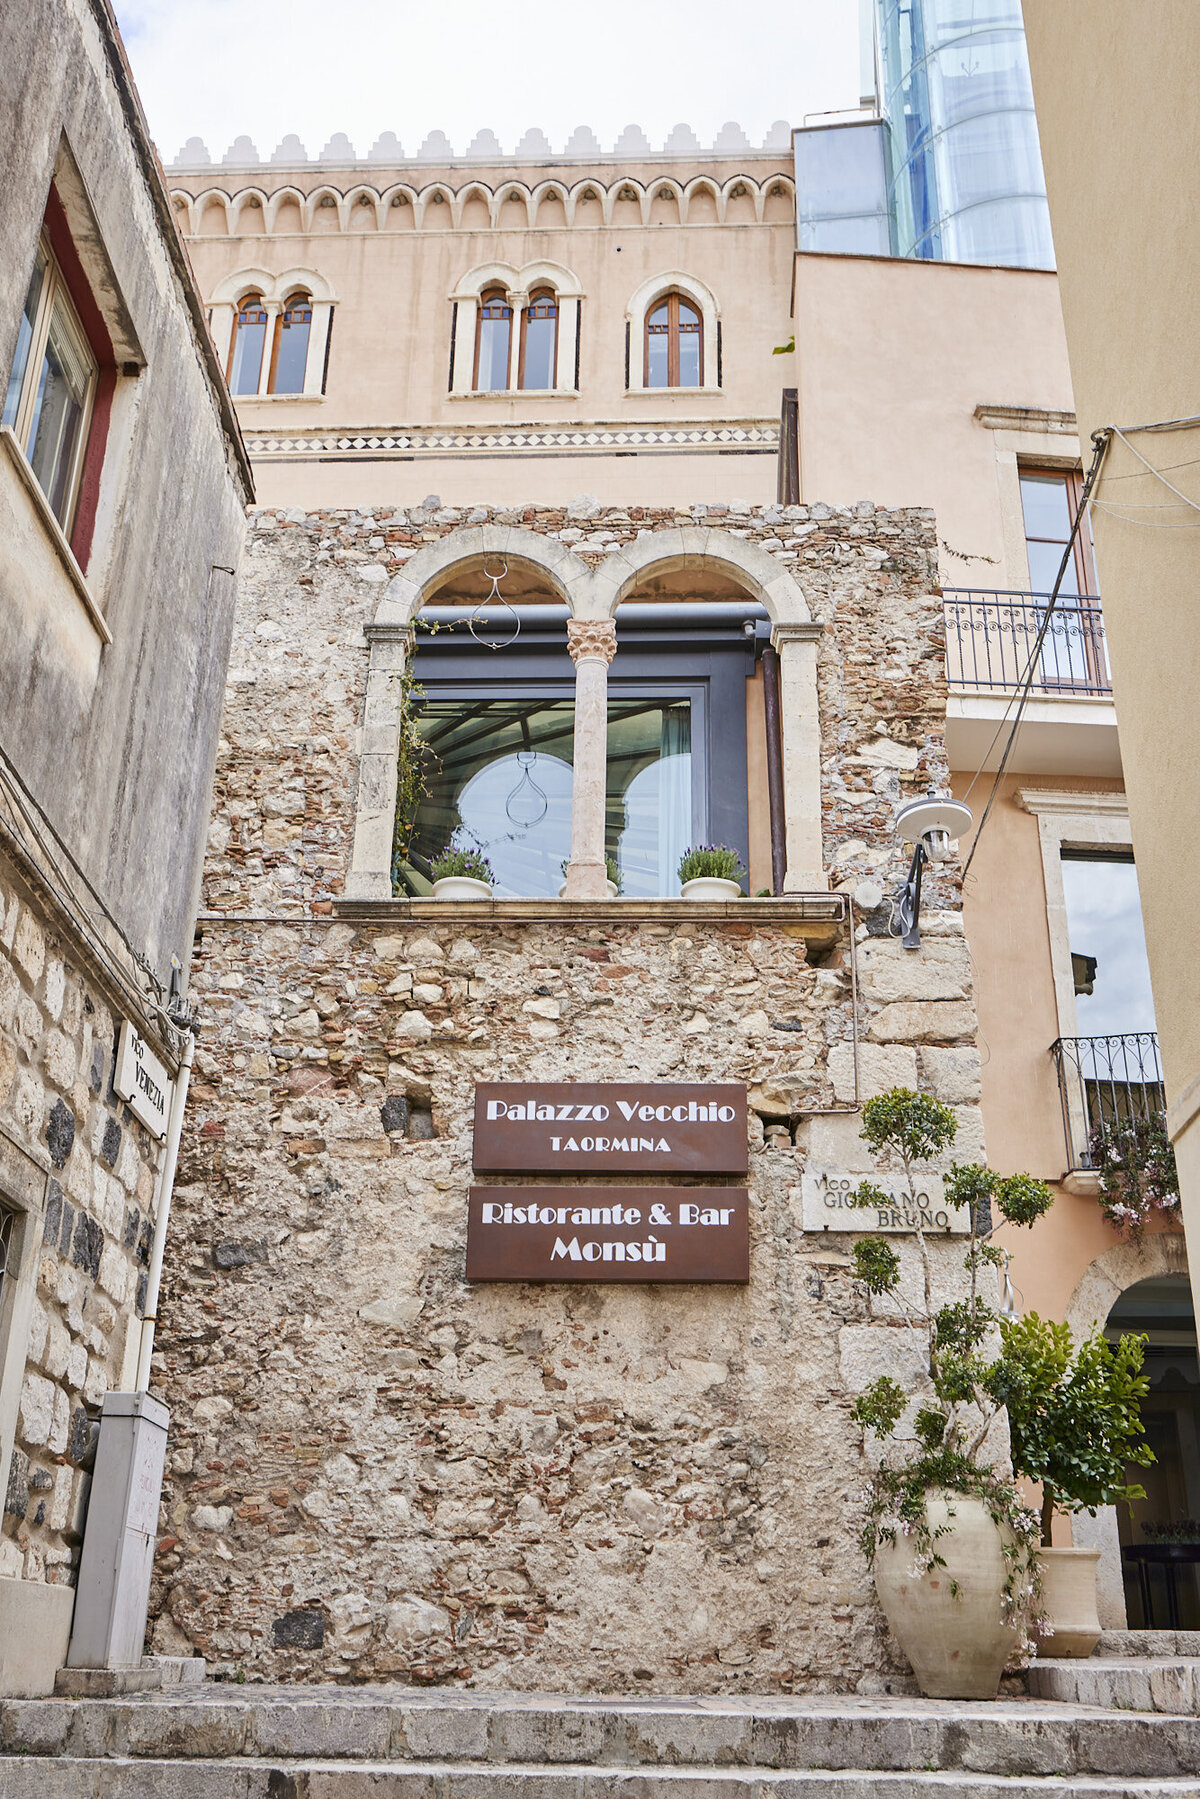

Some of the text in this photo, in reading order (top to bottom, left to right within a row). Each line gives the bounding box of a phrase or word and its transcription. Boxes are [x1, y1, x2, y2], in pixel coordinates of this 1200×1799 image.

[131, 1034, 144, 1059] VICO
[135, 1061, 165, 1115] VENEZIA
[486, 1100, 736, 1123] Palazzo Vecchio
[550, 1136, 672, 1152] TAORMINA
[814, 1179, 851, 1190] VICO
[823, 1191, 930, 1209] GIOANO
[481, 1202, 736, 1226] Ristorante & Bar
[877, 1210, 949, 1228] BRUNO
[550, 1235, 667, 1262] Monsù
